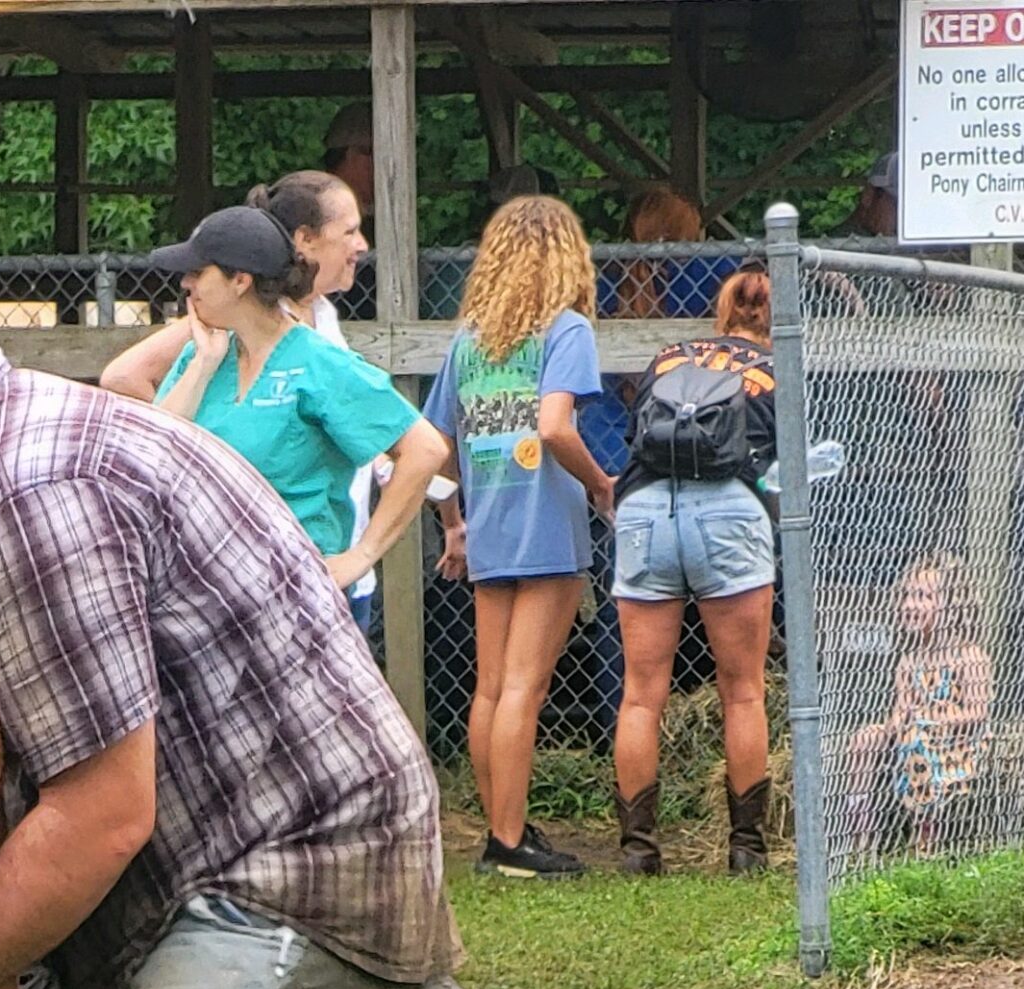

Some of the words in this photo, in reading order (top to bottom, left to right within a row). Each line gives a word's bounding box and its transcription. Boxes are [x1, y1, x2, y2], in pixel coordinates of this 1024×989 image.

[924, 13, 996, 43] KEEP
[918, 65, 943, 85] No
[952, 69, 986, 84] one
[950, 92, 966, 111] in
[961, 118, 1021, 138] unless
[921, 146, 1024, 170] permitted
[931, 174, 969, 197] Pony
